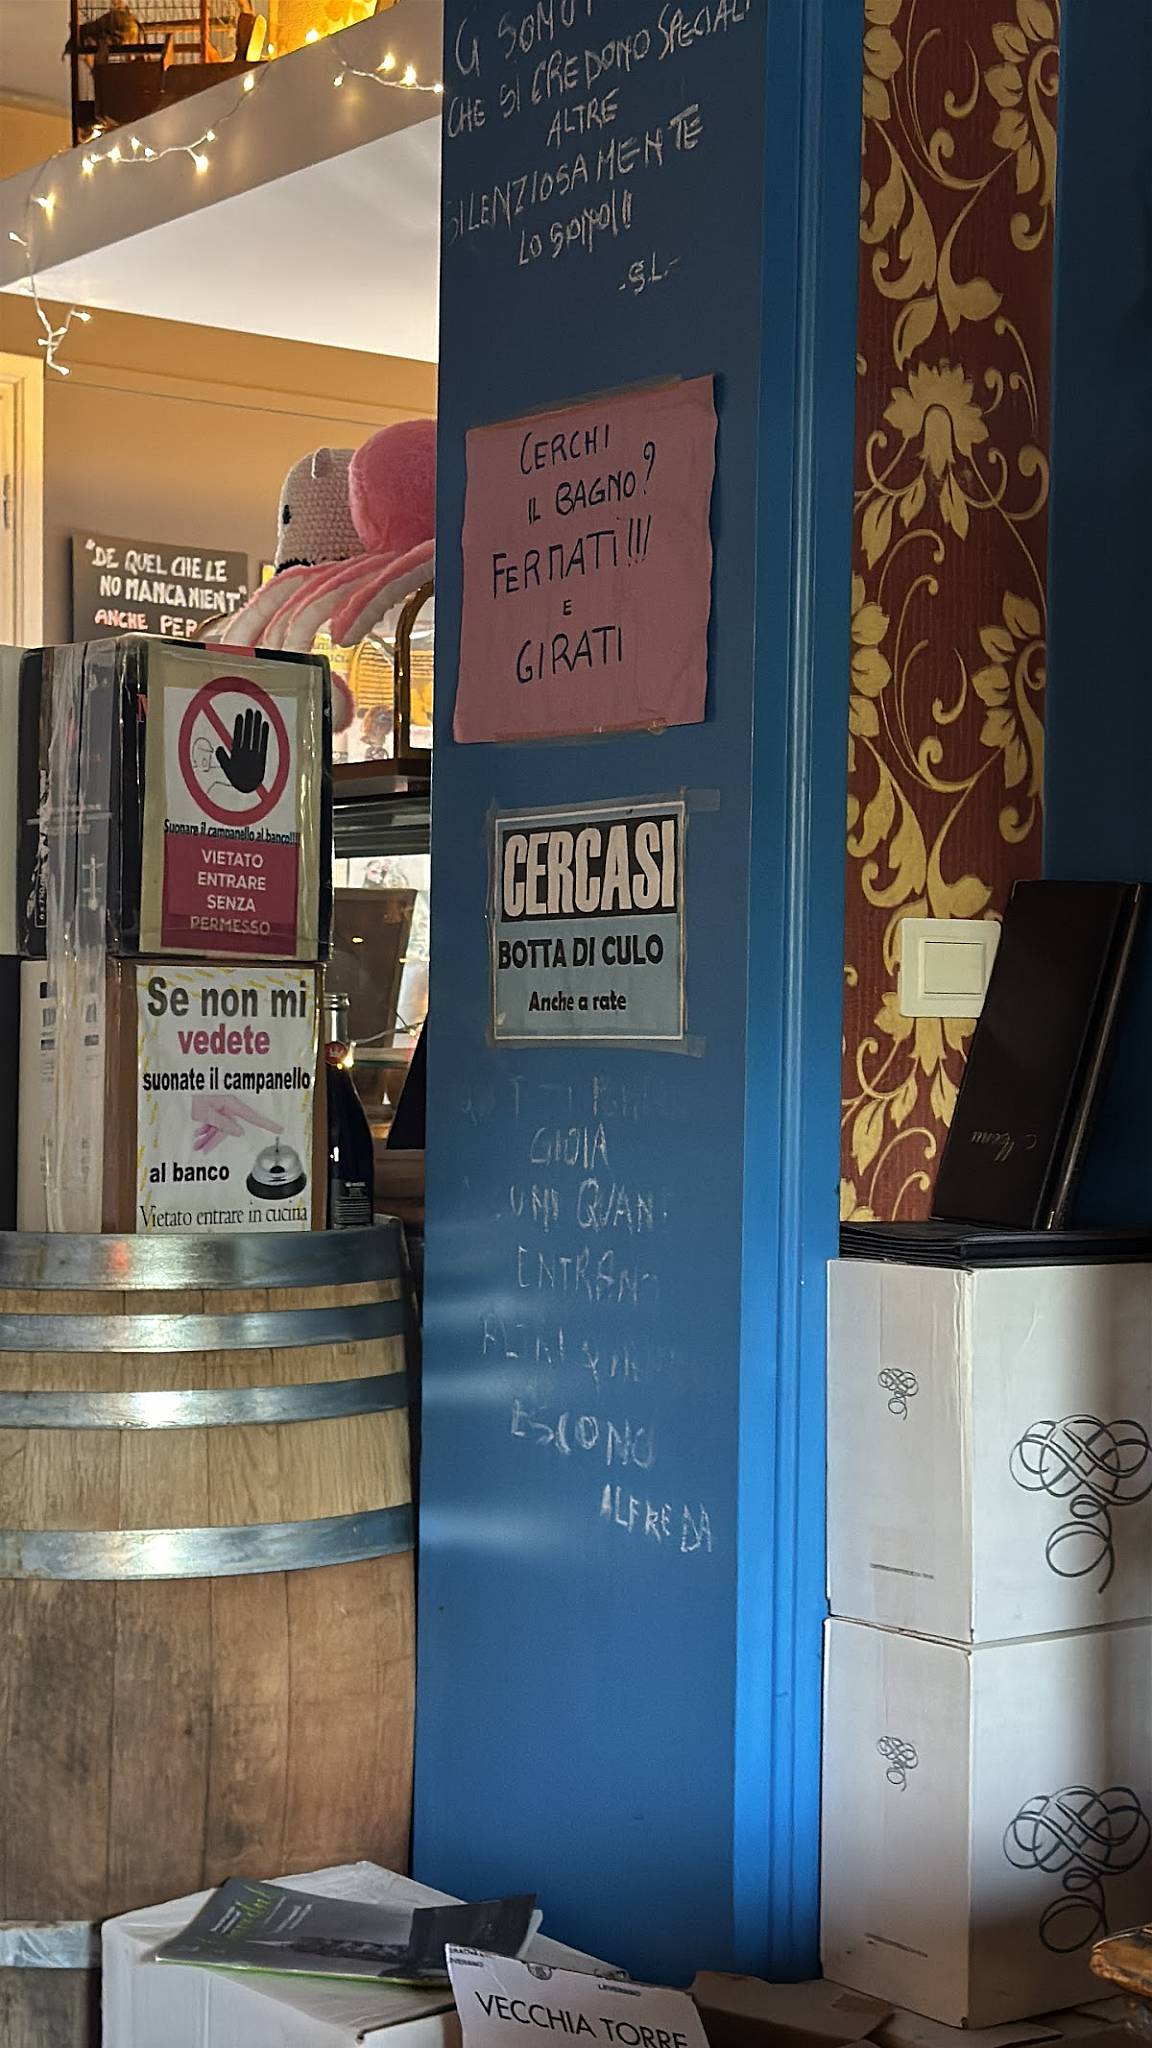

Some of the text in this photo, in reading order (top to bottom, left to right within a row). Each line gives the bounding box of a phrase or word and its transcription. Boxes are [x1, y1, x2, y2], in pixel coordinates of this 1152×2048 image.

[447, 96, 486, 138] CHE
[500, 75, 520, 119] SI
[531, 29, 651, 105] CREDONO
[546, 88, 620, 148] ALTRE
[518, 229, 542, 266] LO
[520, 423, 610, 475] CERCHI
[527, 441, 656, 525] IL BAGNO?
[124, 550, 168, 575] QUEL
[170, 556, 203, 579] CHE
[204, 560, 228, 583] LE
[99, 575, 122, 597] NO
[125, 578, 187, 608] MANCA
[563, 600, 573, 616] E
[94, 608, 149, 630] ANCHE
[516, 625, 623, 684] GIRATI
[201, 848, 264, 869] VIETATO
[503, 819, 676, 918] CERCASI
[197, 871, 267, 891] ENTRARE
[207, 894, 257, 912] SENZA
[190, 915, 271, 936] PERMESSO
[498, 933, 664, 970] BOTTA DI CULO
[147, 976, 307, 1018] Se non mi
[528, 989, 627, 1012] Anche a rate
[177, 1023, 270, 1055] vedete
[143, 1066, 310, 1094] suonate il campanello
[150, 1162, 230, 1183] al banco
[139, 1200, 308, 1228] Vietato entrare in cucina
[475, 1990, 598, 2038] VECCHIA
